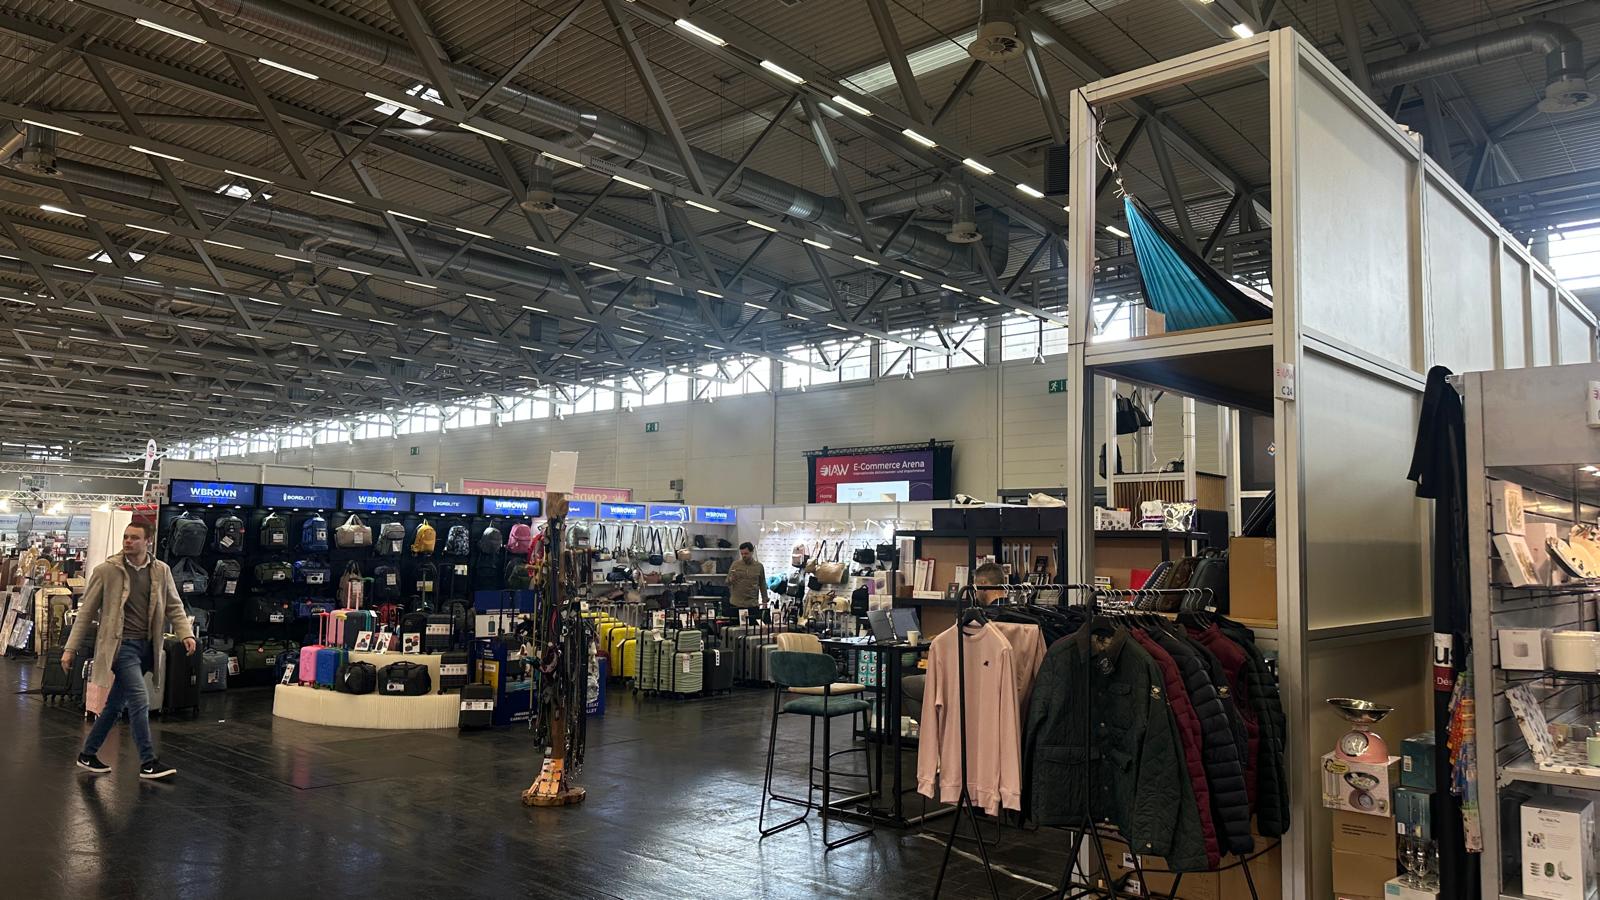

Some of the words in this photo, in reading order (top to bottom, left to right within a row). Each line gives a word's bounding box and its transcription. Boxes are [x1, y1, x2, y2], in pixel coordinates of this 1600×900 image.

[853, 462, 900, 471] E-Commerce
[902, 460, 925, 469] Arena
[190, 487, 237, 498] WBROWN
[358, 495, 397, 505] WBROWN
[495, 500, 528, 510] WBROWN
[610, 505, 637, 514] WBROWN
[705, 511, 727, 519] WBROWN
